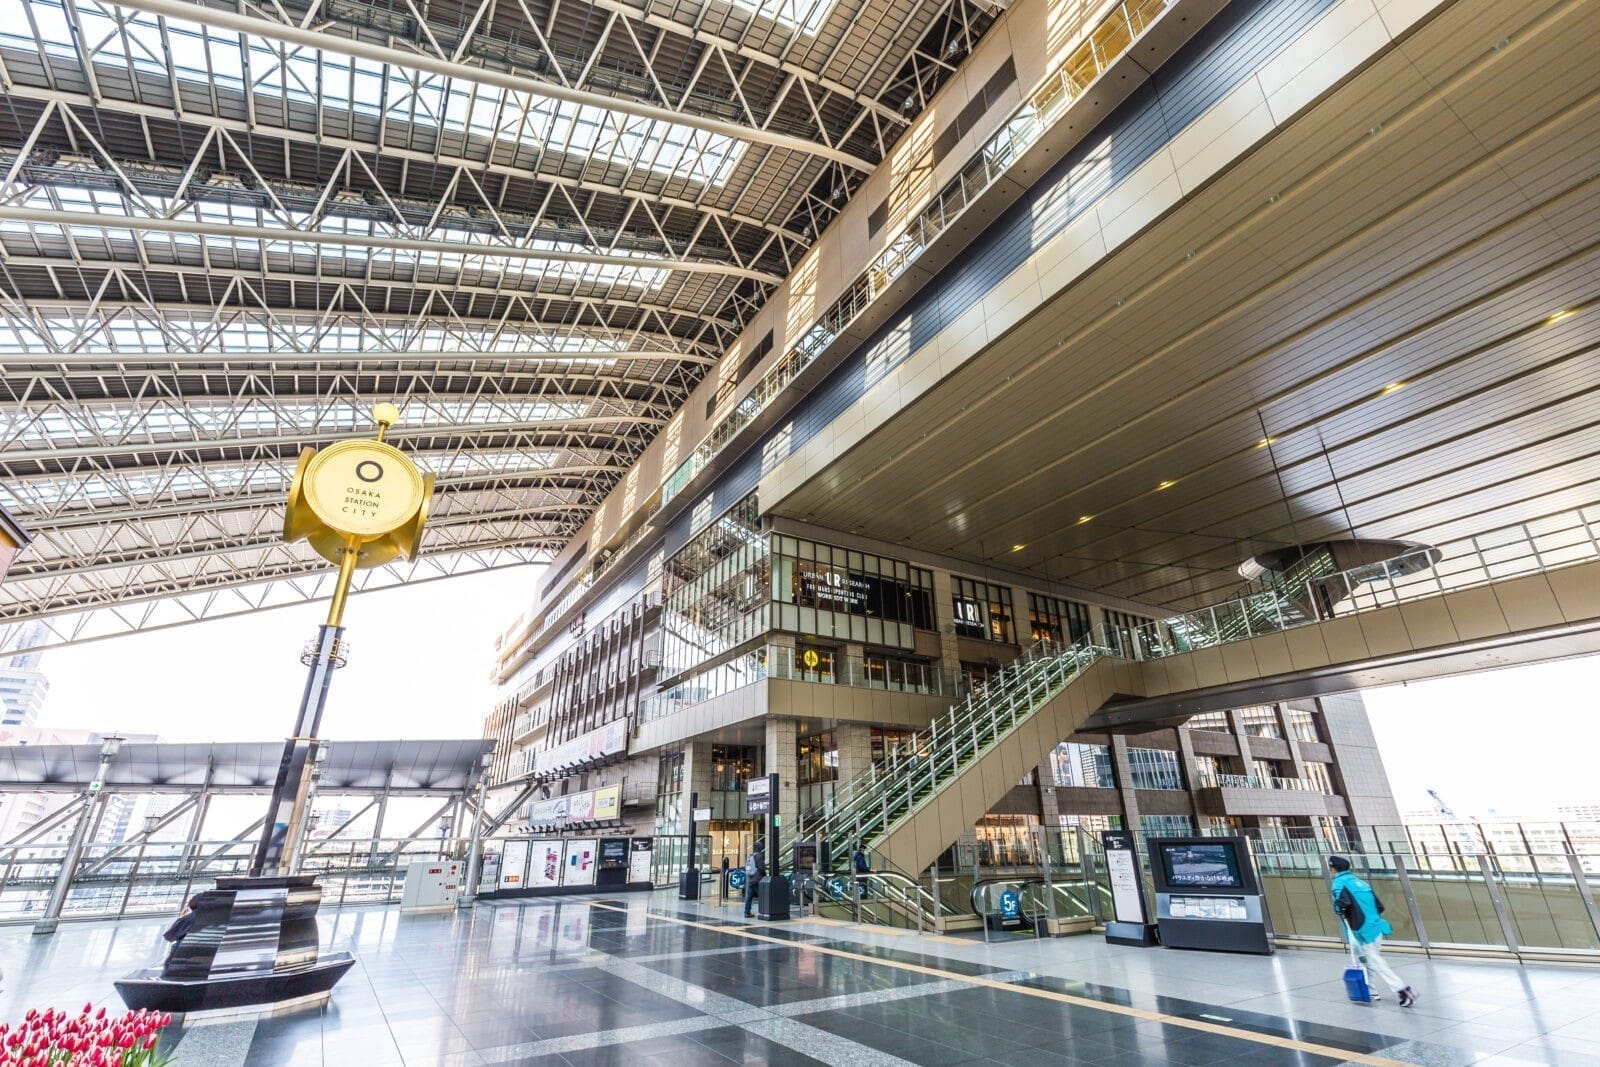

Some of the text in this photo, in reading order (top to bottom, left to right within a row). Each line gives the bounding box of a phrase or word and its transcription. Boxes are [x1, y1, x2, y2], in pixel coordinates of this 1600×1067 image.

[347, 487, 381, 499] OSAKA
[344, 497, 380, 508] STATION
[342, 506, 377, 517] CITY
[1003, 894, 1016, 912] 5F
